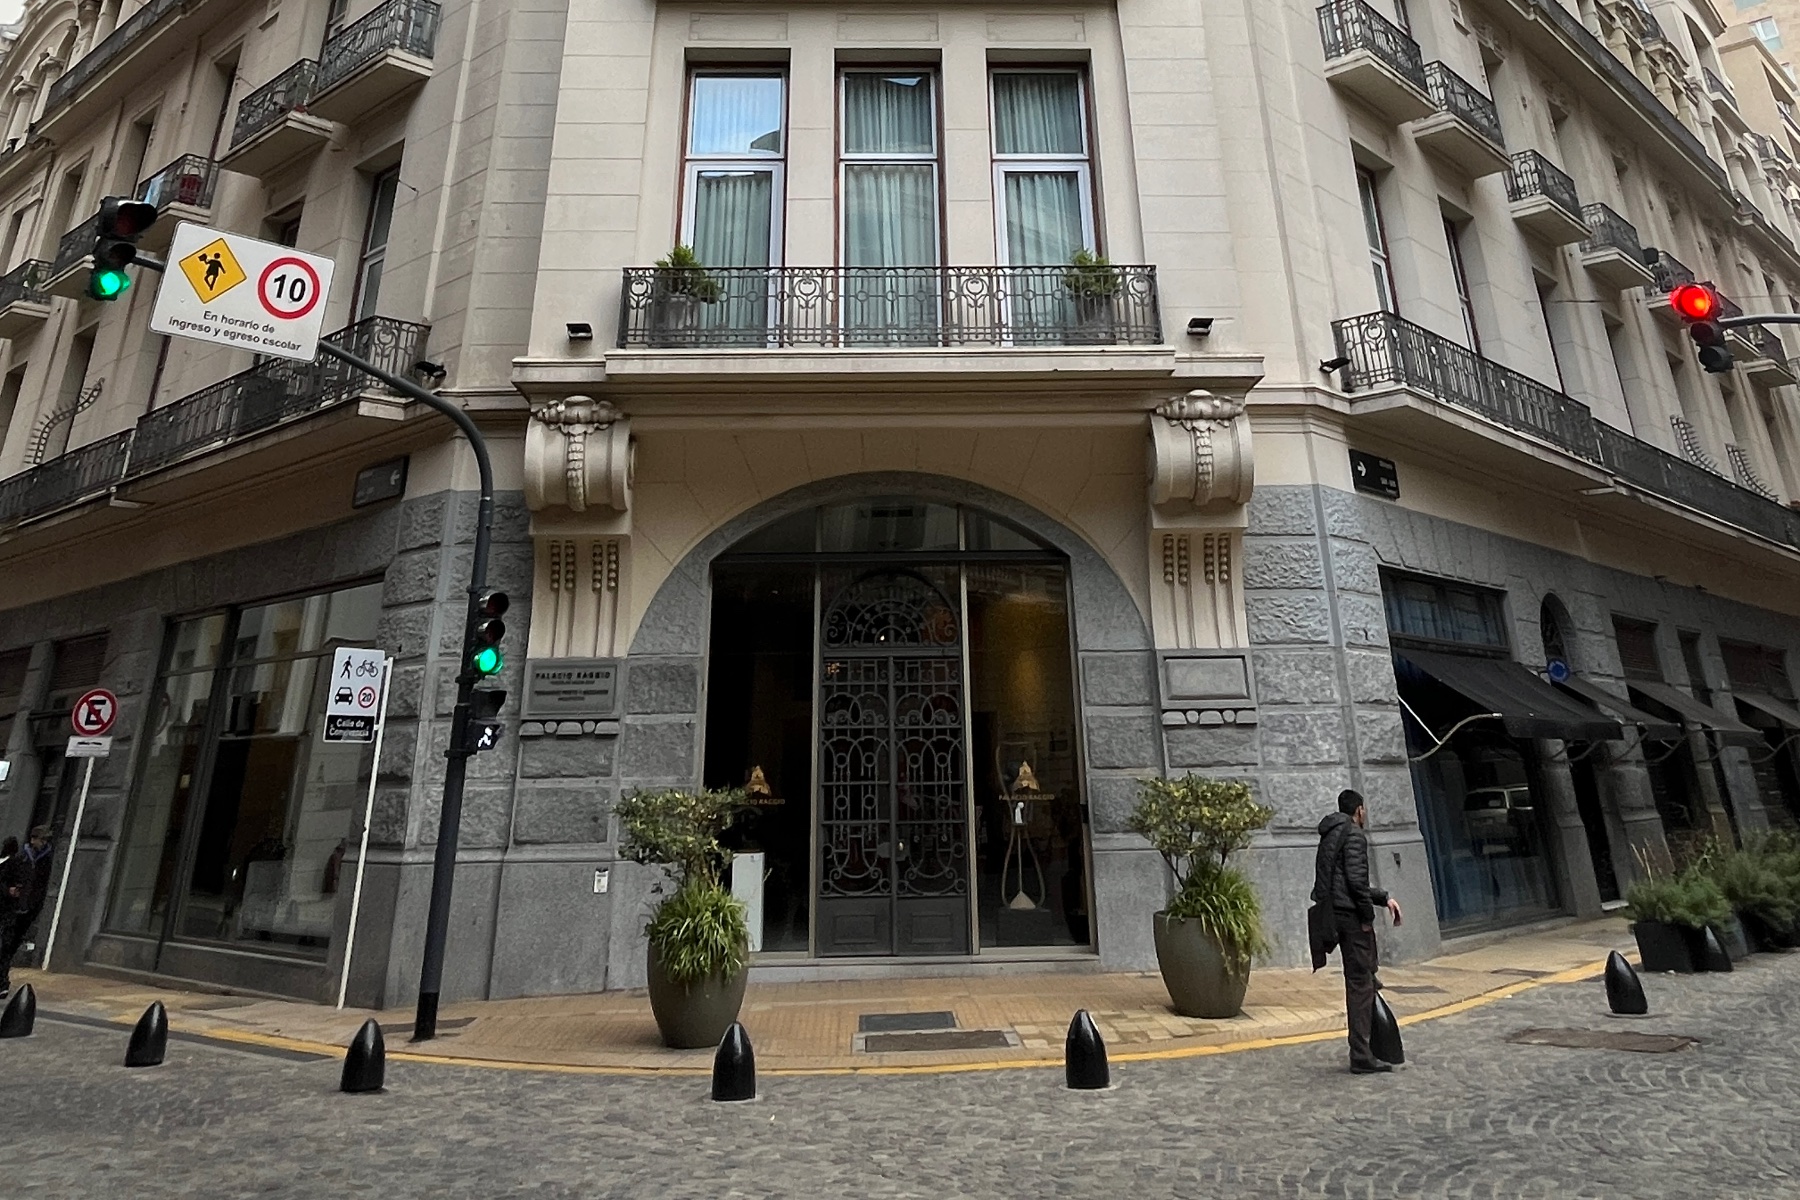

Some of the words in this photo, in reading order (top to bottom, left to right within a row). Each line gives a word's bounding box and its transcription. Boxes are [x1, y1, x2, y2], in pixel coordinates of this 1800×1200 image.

[272, 274, 307, 303] 10
[168, 316, 212, 334] ingreso
[213, 327, 221, 337] y
[223, 329, 260, 344] egreso
[262, 337, 302, 352] escolar
[203, 310, 218, 323] En
[220, 314, 260, 331] horario
[261, 323, 275, 334] de
[361, 692, 373, 703] 20
